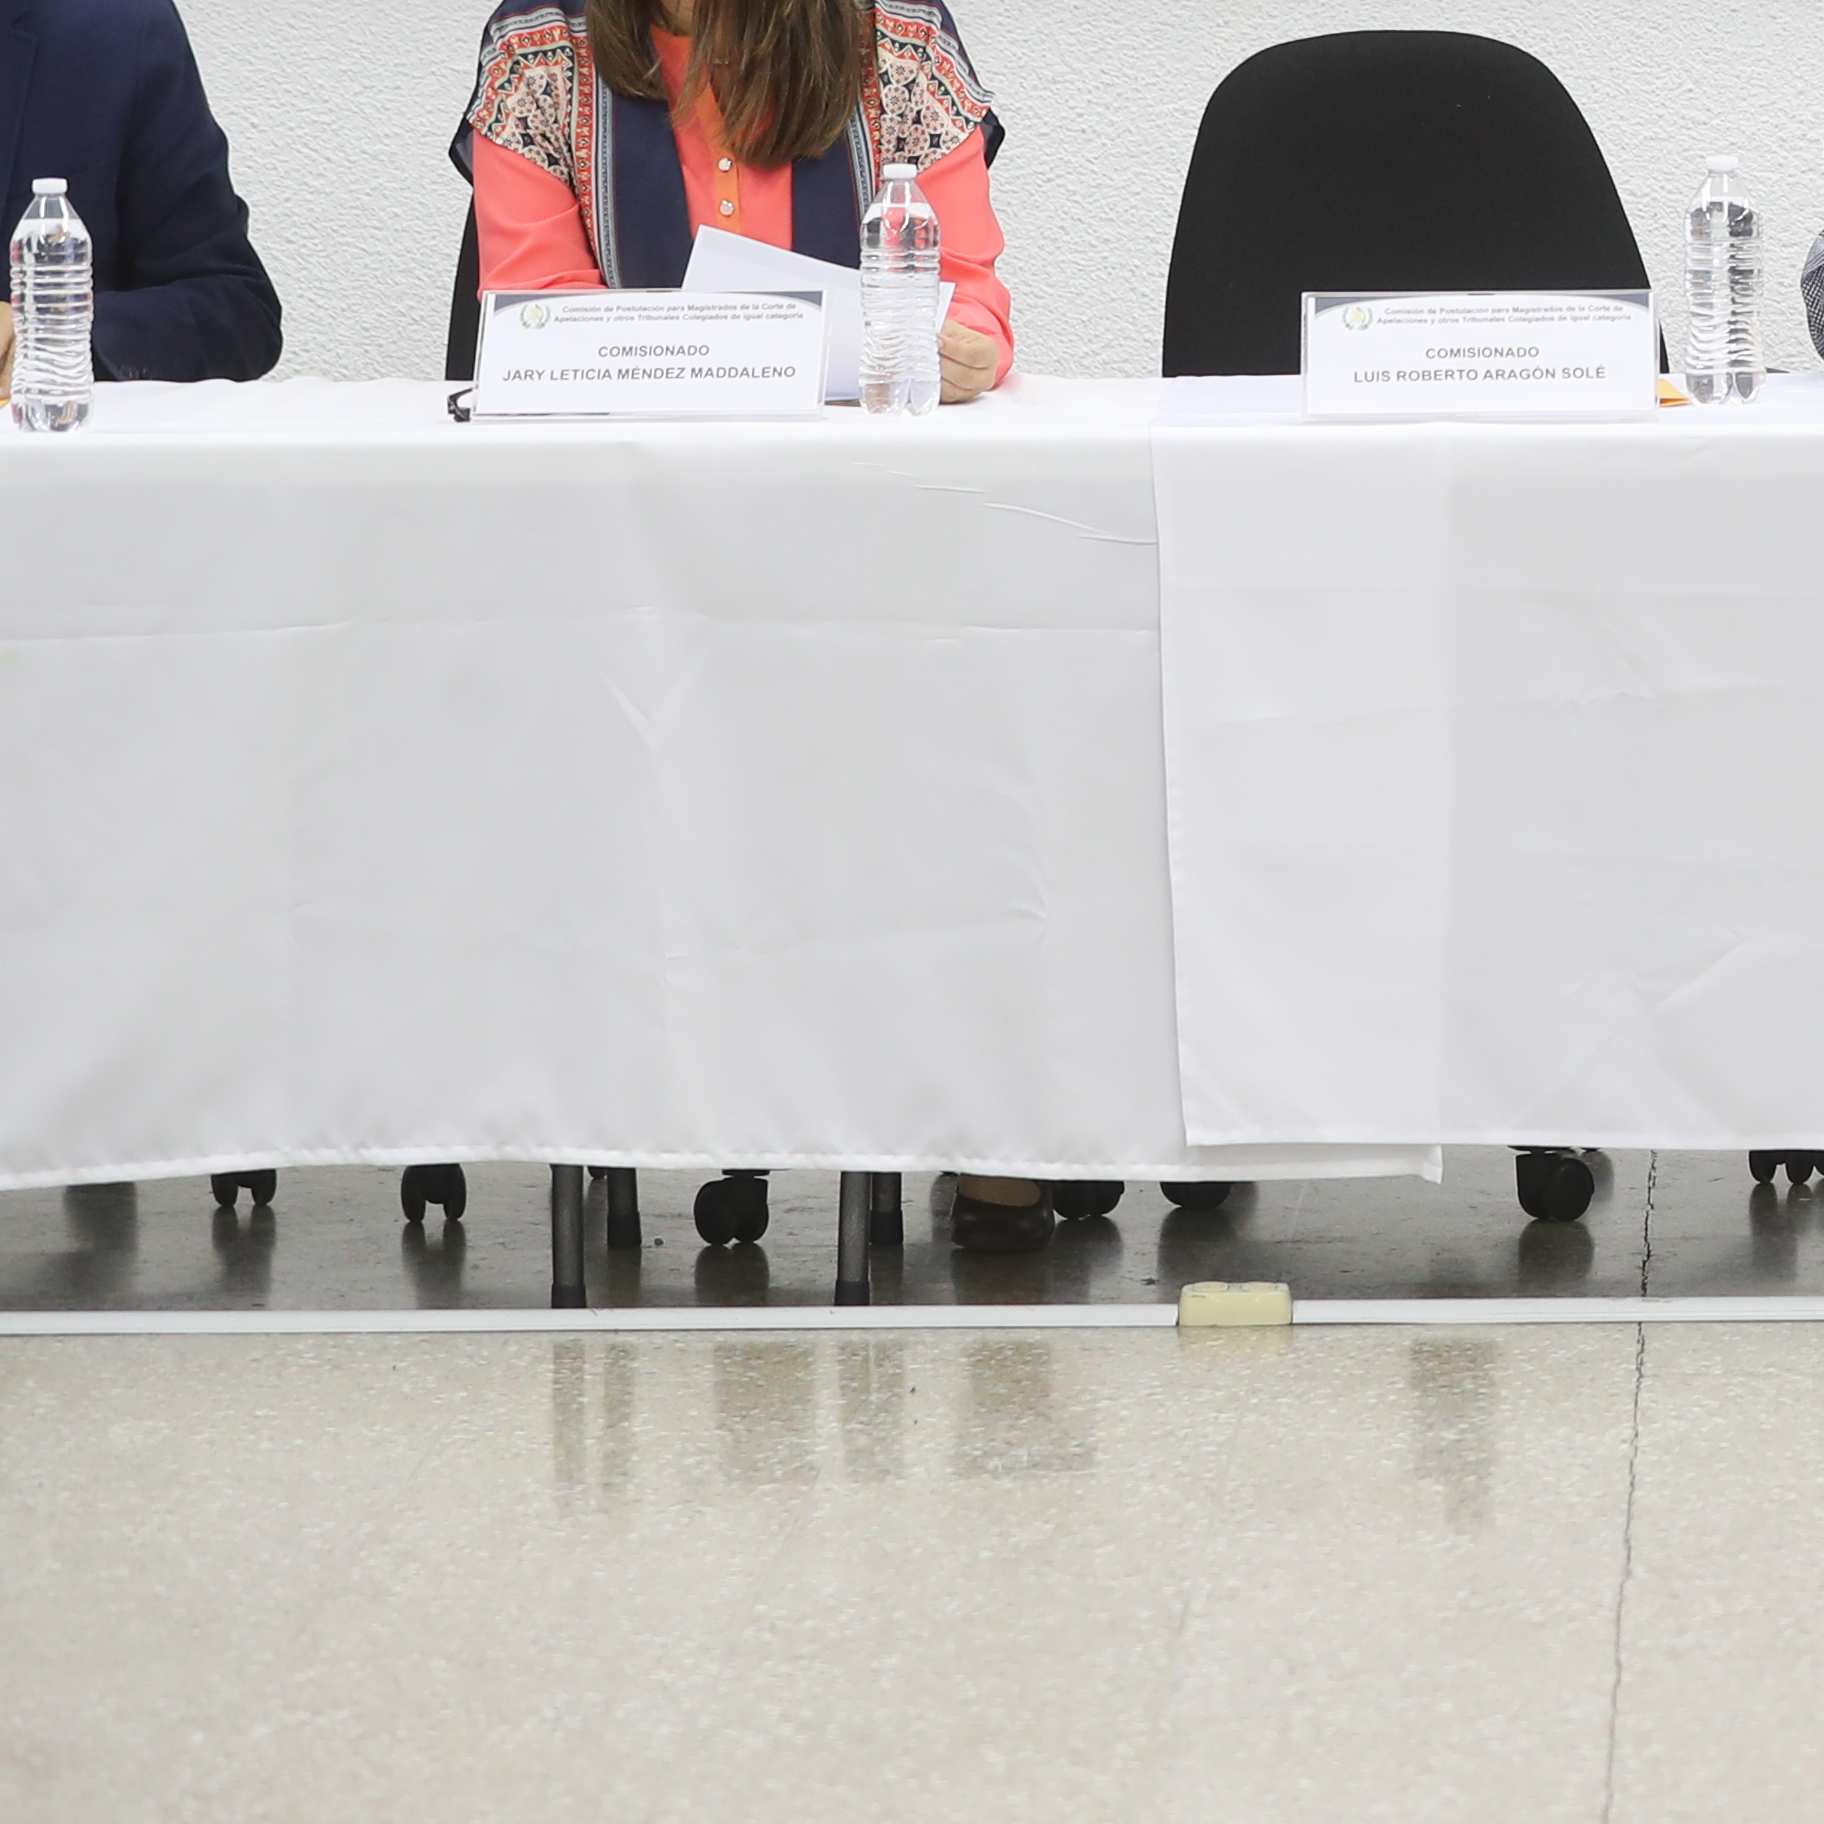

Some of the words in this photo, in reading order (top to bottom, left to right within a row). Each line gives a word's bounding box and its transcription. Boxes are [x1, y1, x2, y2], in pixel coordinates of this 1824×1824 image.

[598, 344, 710, 358] COMISIONADO
[1425, 346, 1540, 360] COMISIONADO
[502, 369, 546, 383] JARY
[550, 368, 612, 382] LETICIA
[617, 364, 686, 380] MÉNDEZ
[690, 366, 796, 379] MADDALENO
[1353, 370, 1392, 383] LUIS
[1396, 368, 1479, 382] ROBERTO
[1483, 365, 1557, 381] ARAGÓN
[1561, 364, 1607, 380] SOLÉ
